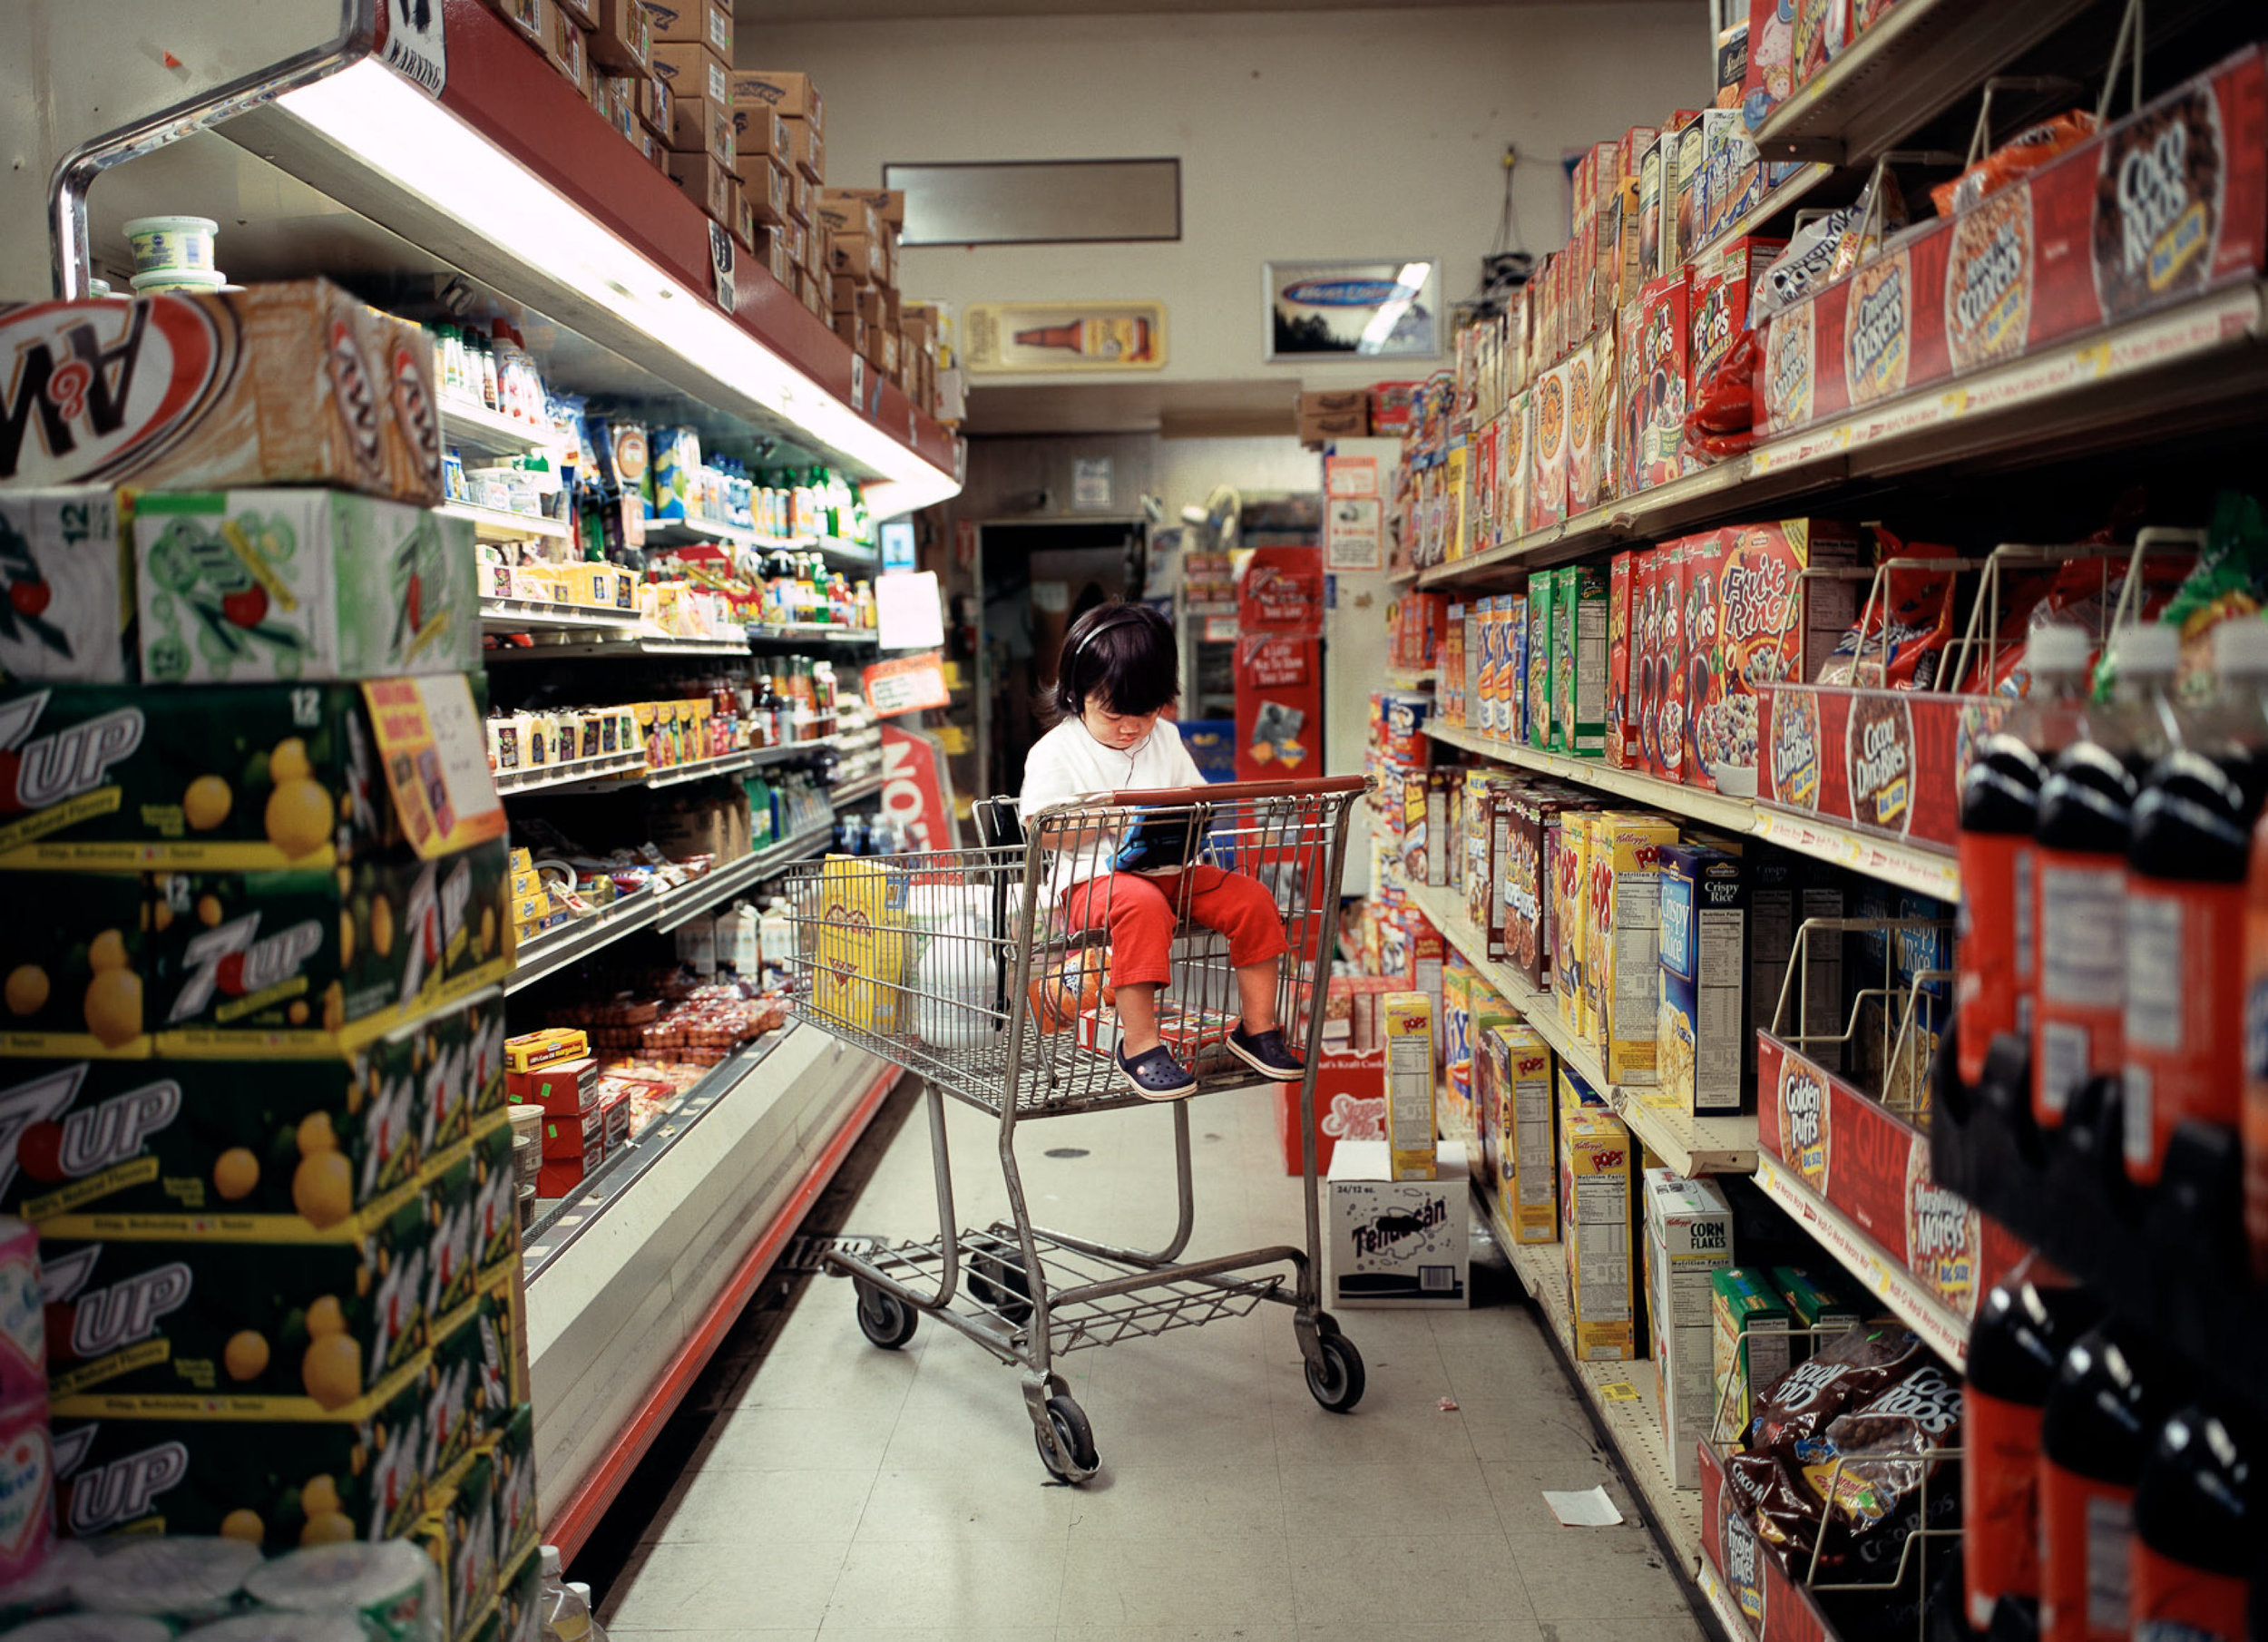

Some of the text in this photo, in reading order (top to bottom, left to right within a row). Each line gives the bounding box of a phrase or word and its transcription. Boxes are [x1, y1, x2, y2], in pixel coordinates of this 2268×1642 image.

[387, 38, 442, 90] WARNING
[2118, 121, 2186, 211] Coco
[1725, 553, 1787, 603] Fruit
[288, 687, 320, 726] 12
[1863, 717, 1896, 761] Cocoa
[1616, 832, 1649, 845] Kellogg's
[1634, 845, 1659, 869] POP
[1705, 880, 1740, 894] Crispy
[1711, 889, 1734, 902] Rice
[1661, 885, 1690, 938] Crispy
[1664, 924, 1683, 963] Rice
[1905, 938, 1931, 972] Rice
[168, 911, 325, 1024] 7UP
[1403, 1016, 1428, 1034] POPS
[1517, 1056, 1545, 1077] POPS
[1785, 1074, 1821, 1113] Golden
[1792, 1110, 1819, 1149] Puffs
[1574, 1140, 1603, 1151] Kellogg's
[1590, 1149, 1625, 1174] POPS
[1337, 1185, 1362, 1194] 24/12
[1666, 1217, 1692, 1227] Kellogg's
[1691, 1222, 1725, 1237] CORN
[1691, 1236, 1726, 1249] FLAKES
[1917, 1212, 1966, 1260] Mateys
[1940, 1262, 1970, 1283] BIG SIZE
